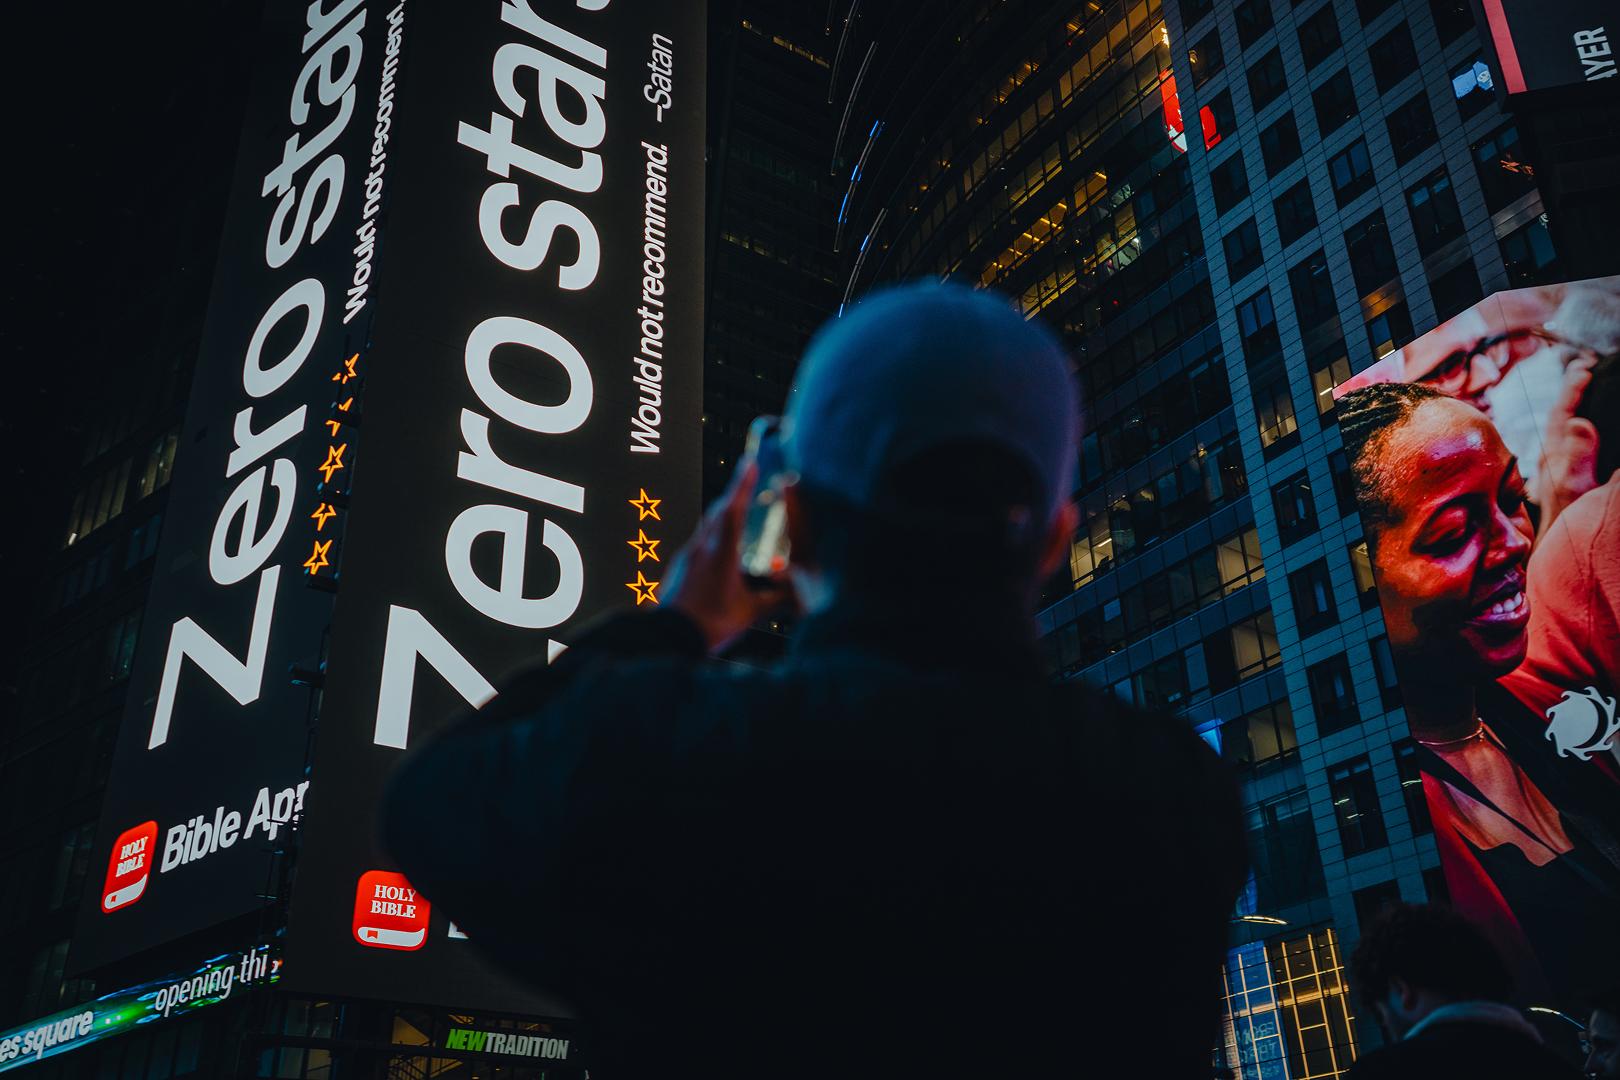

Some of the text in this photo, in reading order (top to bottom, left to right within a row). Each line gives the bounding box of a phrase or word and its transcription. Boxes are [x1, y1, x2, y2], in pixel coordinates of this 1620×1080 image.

[457, 0, 611, 291] star
[343, 217, 376, 325] Would
[363, 162, 386, 220] not
[640, 141, 668, 309] recommend.
[638, 306, 665, 359] not
[631, 356, 663, 454] Would
[148, 278, 325, 750] Zero
[115, 853, 146, 878] BIBLE
[120, 836, 149, 860] HOLY
[160, 806, 242, 874] Bible
[370, 900, 416, 919] BIBLE
[374, 884, 417, 902] HOLY
[21, 1011, 94, 1060] square
[154, 964, 236, 1018] opening
